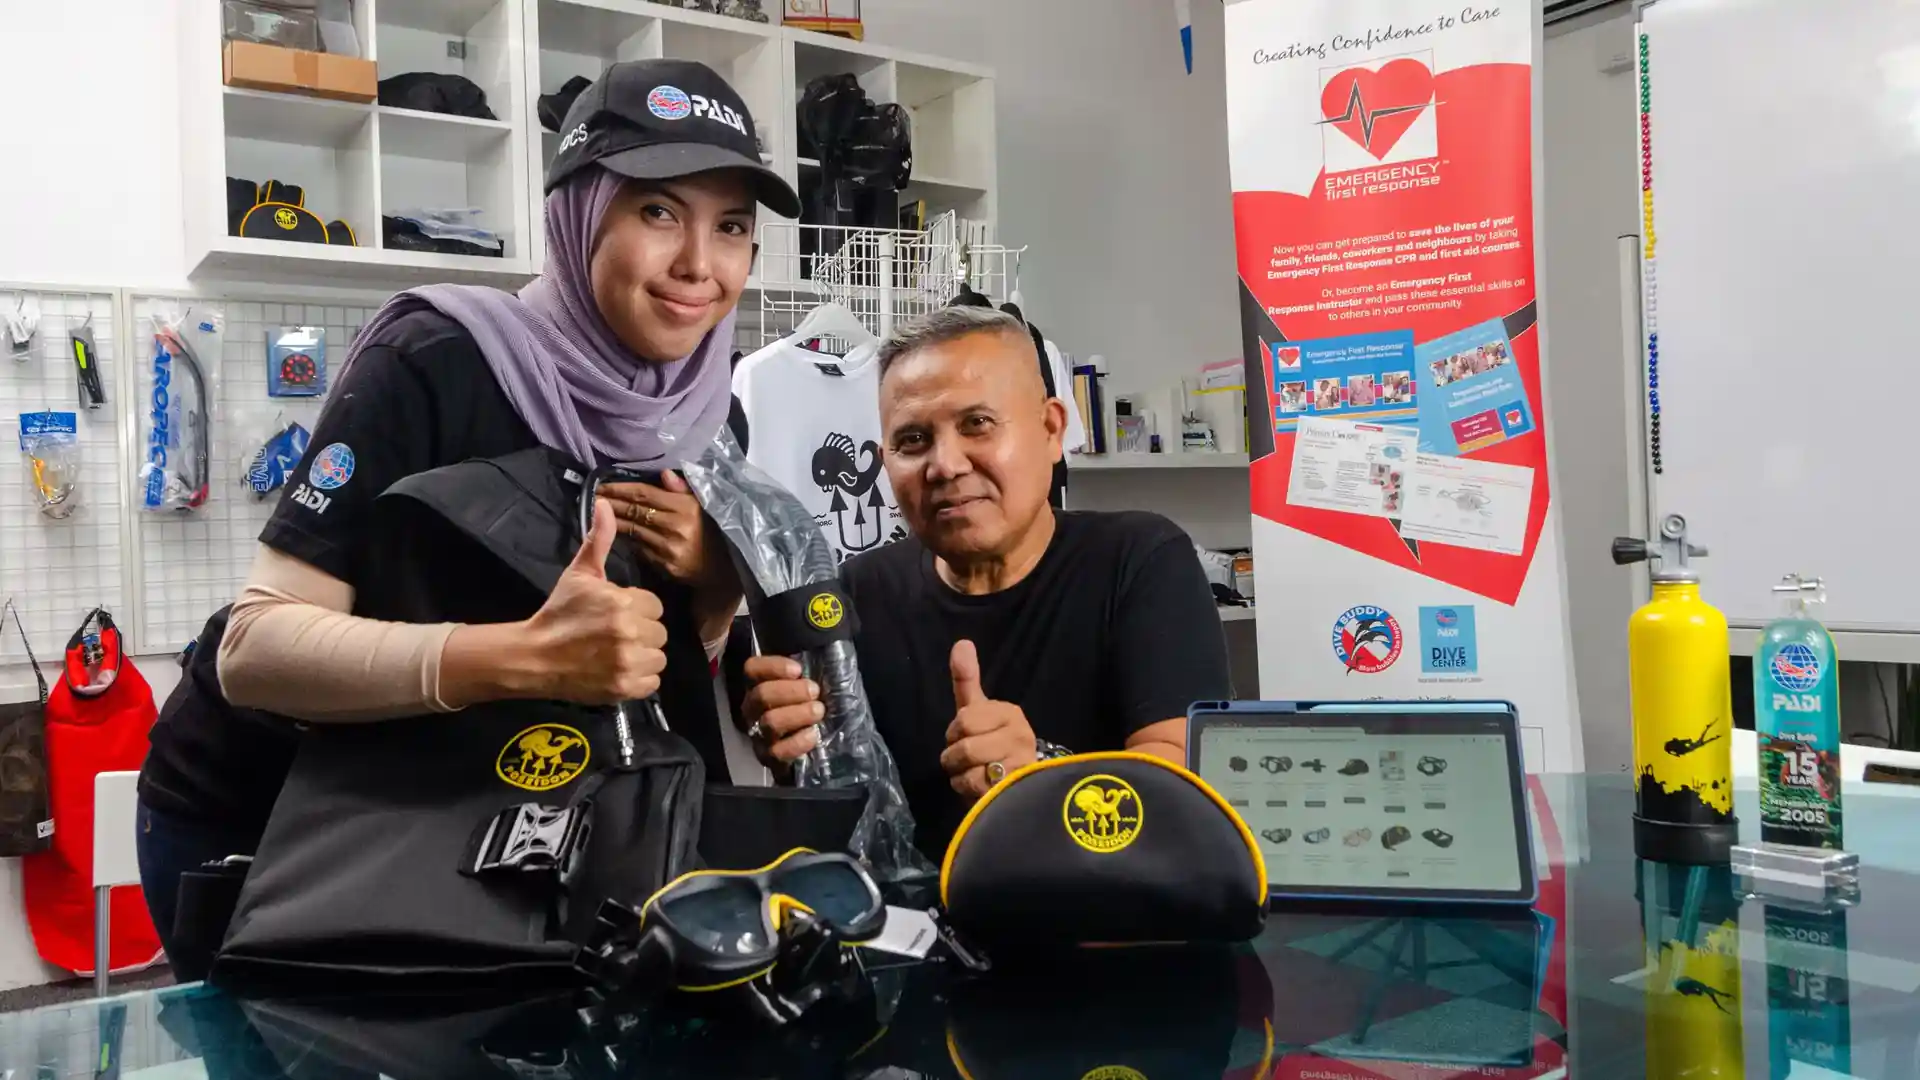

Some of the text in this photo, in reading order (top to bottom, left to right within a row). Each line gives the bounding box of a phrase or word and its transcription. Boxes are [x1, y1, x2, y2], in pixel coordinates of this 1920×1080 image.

[1253, 7, 1500, 64] Creating Confidence to Care
[691, 95, 747, 136] PADI
[1325, 161, 1440, 189] EMERGENCY
[1325, 176, 1440, 201] first response
[1270, 228, 1518, 268] family, friends, coworkers and neighbours by taking
[1273, 215, 1515, 255] Now you can get prepared to save the lives of your
[1267, 267, 1320, 280] Emergency
[1322, 263, 1344, 273] First
[1346, 258, 1393, 271] Response
[1395, 253, 1417, 264] CPR
[1419, 250, 1438, 261] and
[1440, 247, 1462, 259] first
[1463, 245, 1479, 256] aid
[1268, 278, 1526, 316] Response Instructor and pass these essential skills on
[1336, 284, 1373, 296] become
[1376, 283, 1388, 291] an
[1390, 275, 1446, 290] Emergency
[1448, 272, 1472, 283] First
[1328, 313, 1338, 321] to
[1340, 308, 1370, 320] others
[1372, 308, 1381, 317] in
[1383, 305, 1404, 317] your
[291, 483, 332, 514] PADI
[1333, 606, 1384, 656] DIVE BUDDY
[1432, 647, 1465, 659] DIVE
[1432, 659, 1466, 668] CENTER
[1772, 693, 1822, 712] PADI
[1783, 751, 1818, 776] 15
[1780, 808, 1825, 824] 2005
